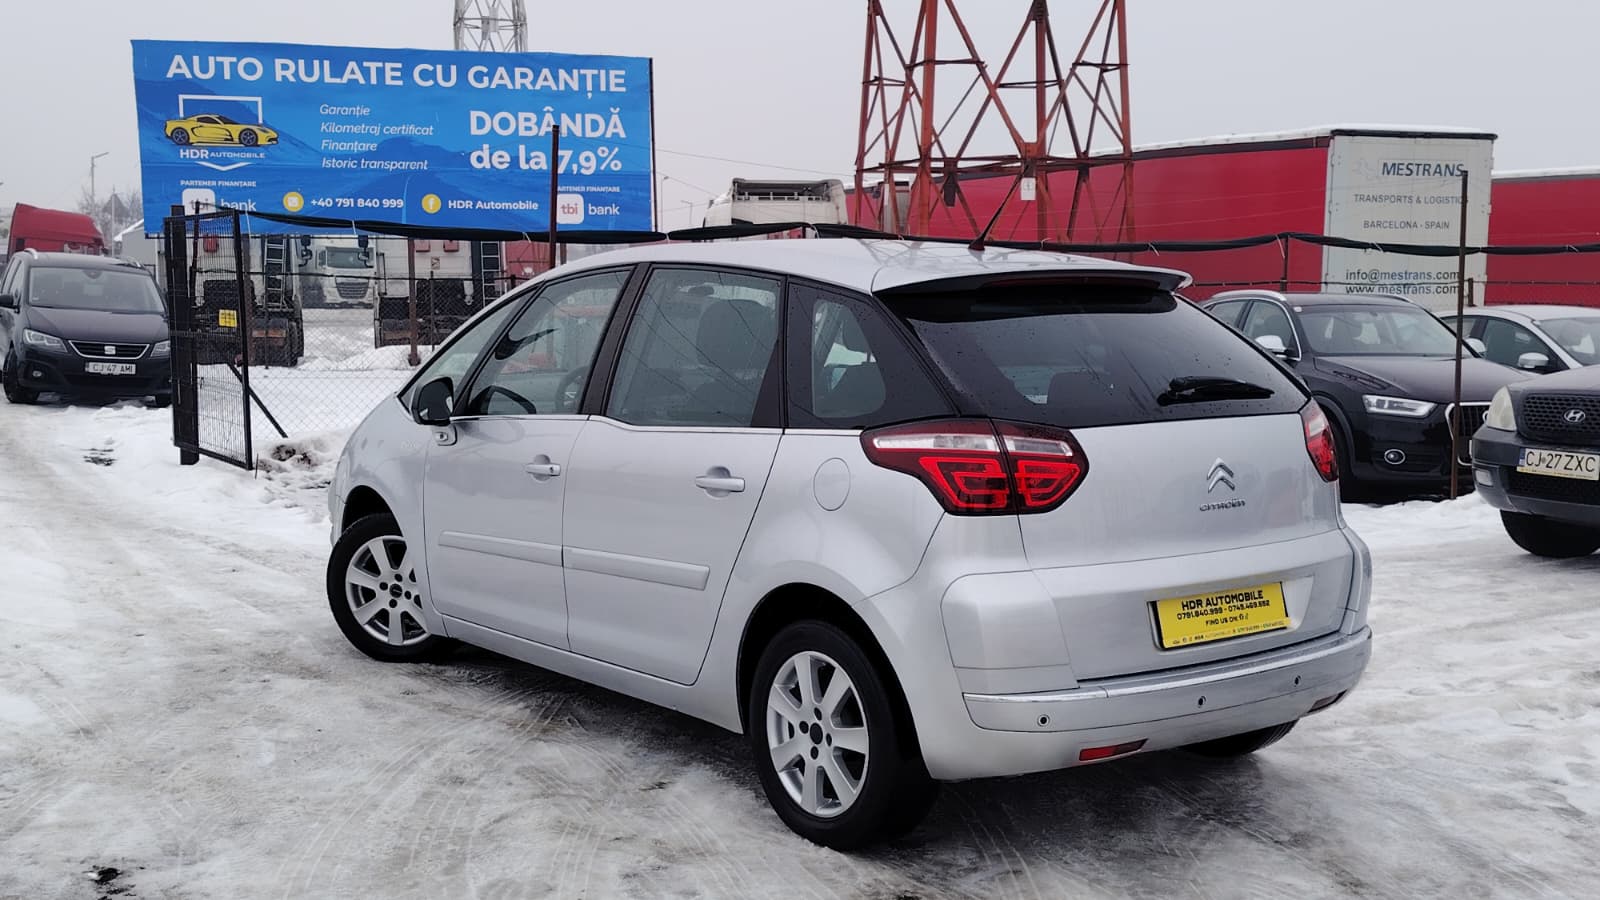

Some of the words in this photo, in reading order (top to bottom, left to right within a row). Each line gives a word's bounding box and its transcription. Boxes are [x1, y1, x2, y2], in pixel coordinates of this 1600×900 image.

[166, 54, 264, 81] AUTO
[274, 58, 404, 86] RULATE
[412, 63, 457, 88] CU
[467, 65, 627, 99] GARANȚIE
[319, 103, 371, 118] Garanție
[320, 121, 381, 136] Kilometraj
[383, 123, 435, 136] certificat
[470, 106, 627, 138] DOBÂNDĂ
[179, 148, 209, 159] HDR
[209, 151, 266, 159] AUTOMOBILE
[321, 139, 378, 153] Finanțare
[322, 156, 358, 169] Istoric
[360, 158, 429, 171] transparent
[470, 144, 512, 170] de
[518, 144, 548, 171] la
[557, 146, 622, 176] 7,9%
[1381, 161, 1464, 177] MESTRANS
[220, 198, 257, 212] bank
[311, 197, 334, 208] +40
[335, 198, 355, 208] 791
[357, 198, 380, 208] 840
[382, 198, 404, 209] 999
[448, 199, 473, 210] HDR
[475, 200, 539, 211] Automobile
[1354, 193, 1415, 204] TRANSPORTS
[1415, 196, 1422, 204] &
[561, 202, 578, 215] tbi
[587, 203, 621, 216] bank
[1363, 220, 1418, 230] BARCELONA
[1424, 220, 1450, 230] SPAIN
[1345, 268, 1460, 283] info@mestrans.com
[1345, 284, 1460, 295] wwwmestrans.com
[1526, 450, 1542, 467] CJ
[1545, 453, 1562, 469] 27
[1563, 454, 1596, 473] ZXC
[1181, 598, 1203, 612] HDR
[1205, 590, 1264, 607] AUTOMOBILE
